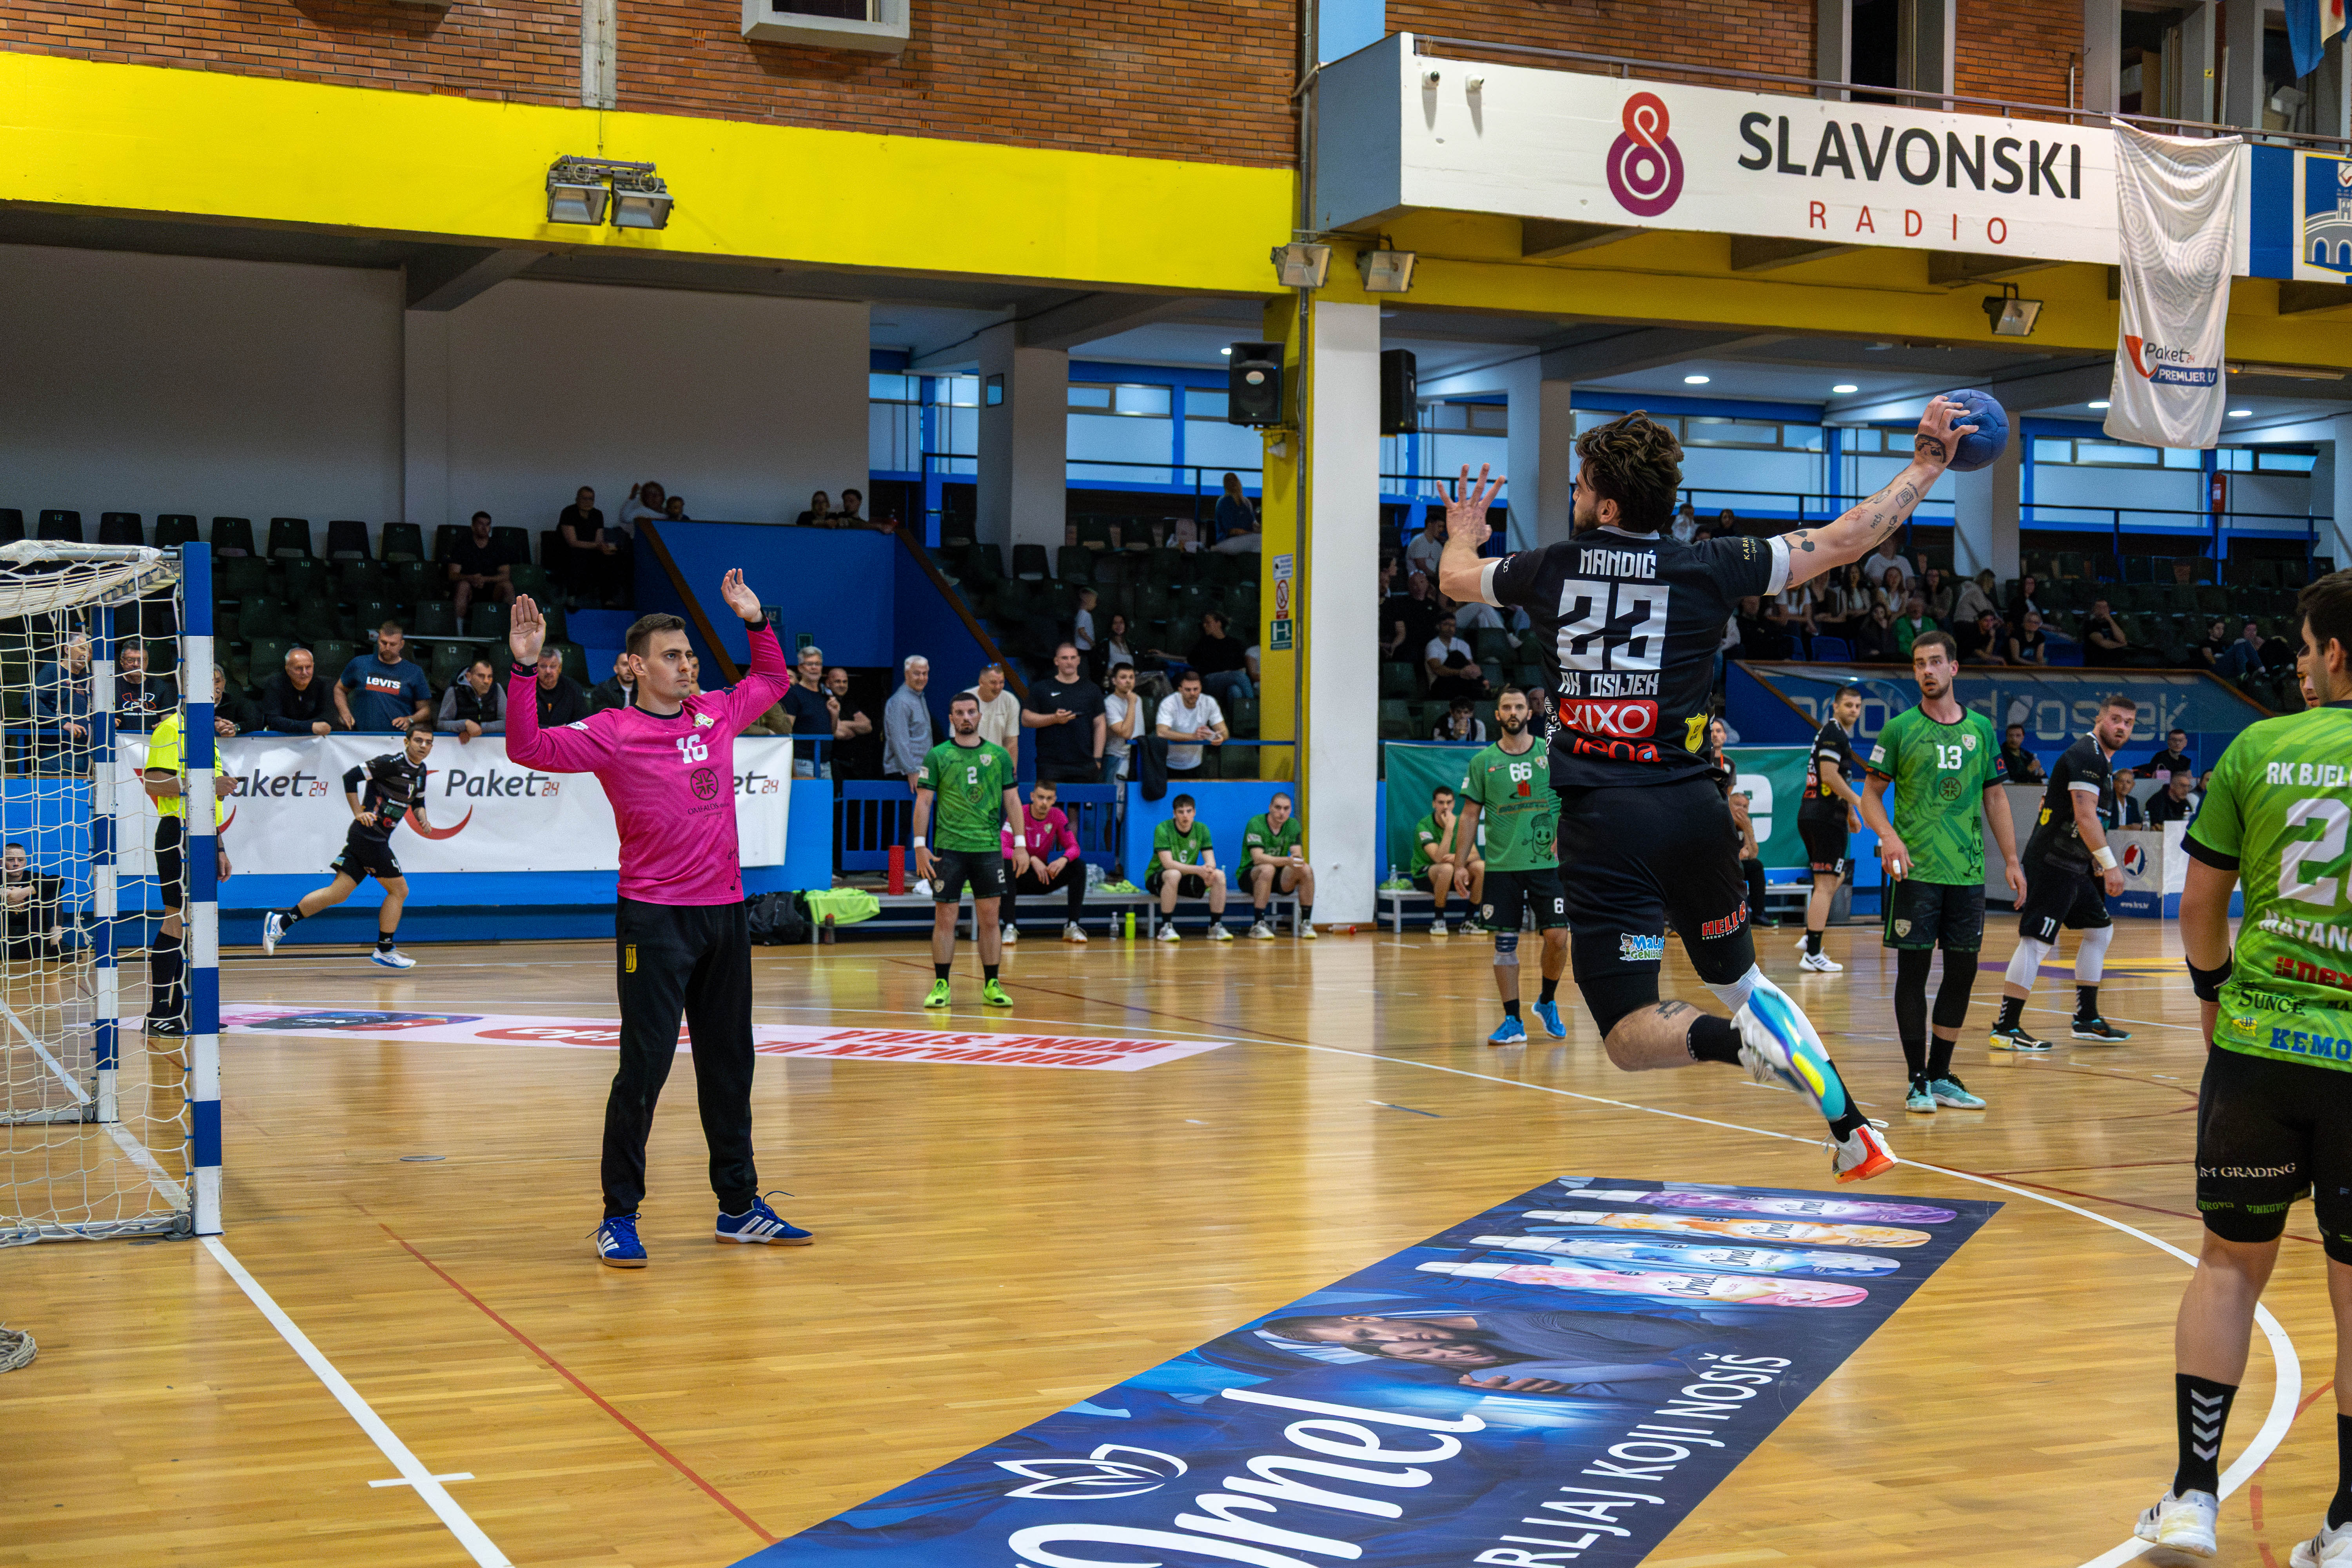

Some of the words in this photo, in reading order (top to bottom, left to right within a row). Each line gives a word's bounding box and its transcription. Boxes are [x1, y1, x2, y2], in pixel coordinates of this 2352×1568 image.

[1737, 112, 2081, 200] SLAVONSKI
[1809, 200, 2008, 245] RADIO
[2145, 342, 2190, 363] Paket
[1579, 548, 1657, 579] MANDIĆ
[1557, 579, 1670, 671] 23
[1558, 672, 1580, 696] RK
[1590, 673, 1660, 697] OSIJEK
[1566, 703, 1650, 733] XIXO
[676, 733, 709, 764] 16
[1936, 744, 1962, 770] 13
[222, 768, 317, 797] aket
[308, 781, 328, 797] 24
[445, 769, 549, 797] Paket
[541, 781, 559, 797] 24
[967, 766, 978, 784] 2
[1509, 762, 1532, 782] 66
[2266, 762, 2296, 785] RK
[2298, 763, 2352, 788] BJEL
[762, 779, 778, 794] 24
[2278, 798, 2352, 907] 2
[2040, 916, 2056, 938] 11
[2238, 989, 2306, 1016] SUNCE
[817, 1030, 994, 1045] STILA
[979, 1037, 1176, 1053] IKONE
[804, 1044, 1127, 1066] ODUVIJEK
[2220, 1162, 2297, 1178] GRADING
[1784, 1199, 1826, 1216] Ornel
[1750, 1222, 1795, 1239] Ornel
[1709, 1247, 1757, 1267] Ornel
[1666, 1275, 1718, 1296] Ornel
[1580, 1424, 1726, 1481] KOJI
[1653, 1352, 1793, 1420] NOSIŠ
